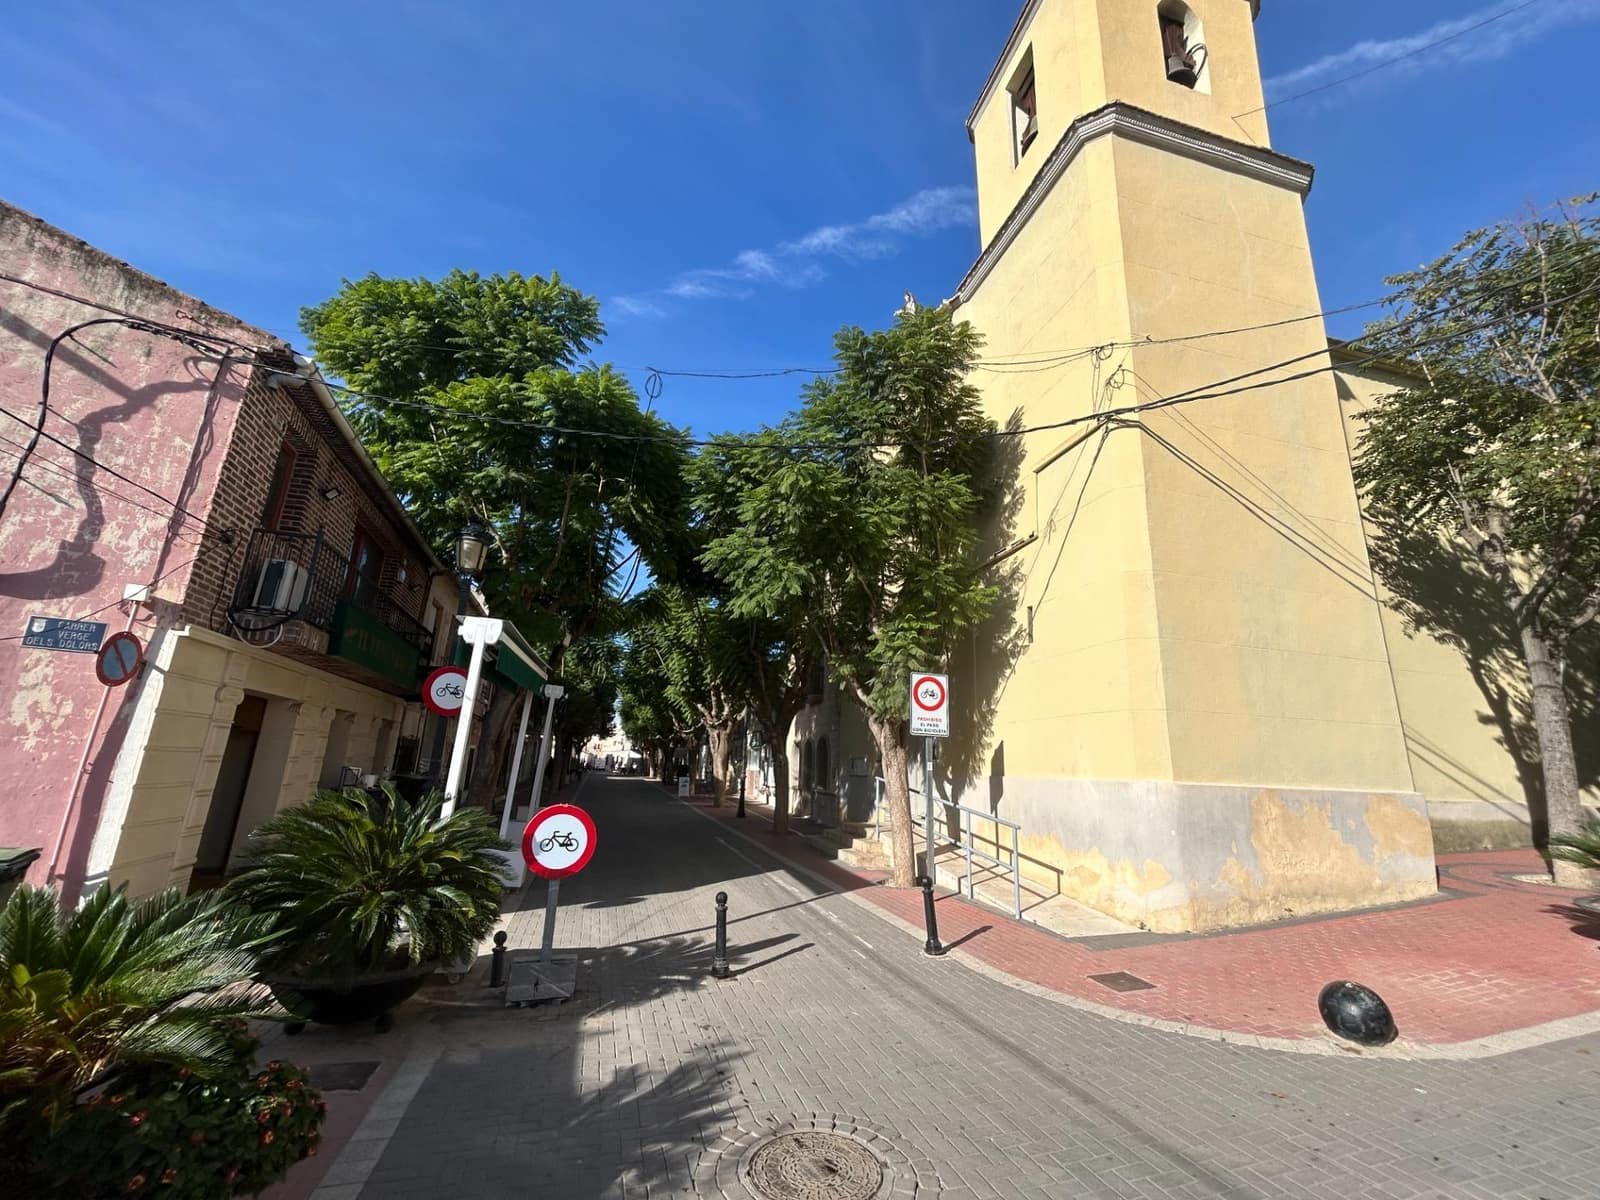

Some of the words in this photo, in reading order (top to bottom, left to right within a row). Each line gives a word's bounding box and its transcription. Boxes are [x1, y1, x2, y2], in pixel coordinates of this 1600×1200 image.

[58, 621, 96, 633] CARRER
[58, 630, 91, 641] VERGE
[26, 636, 53, 647] DELS
[59, 639, 98, 651] DOLORS
